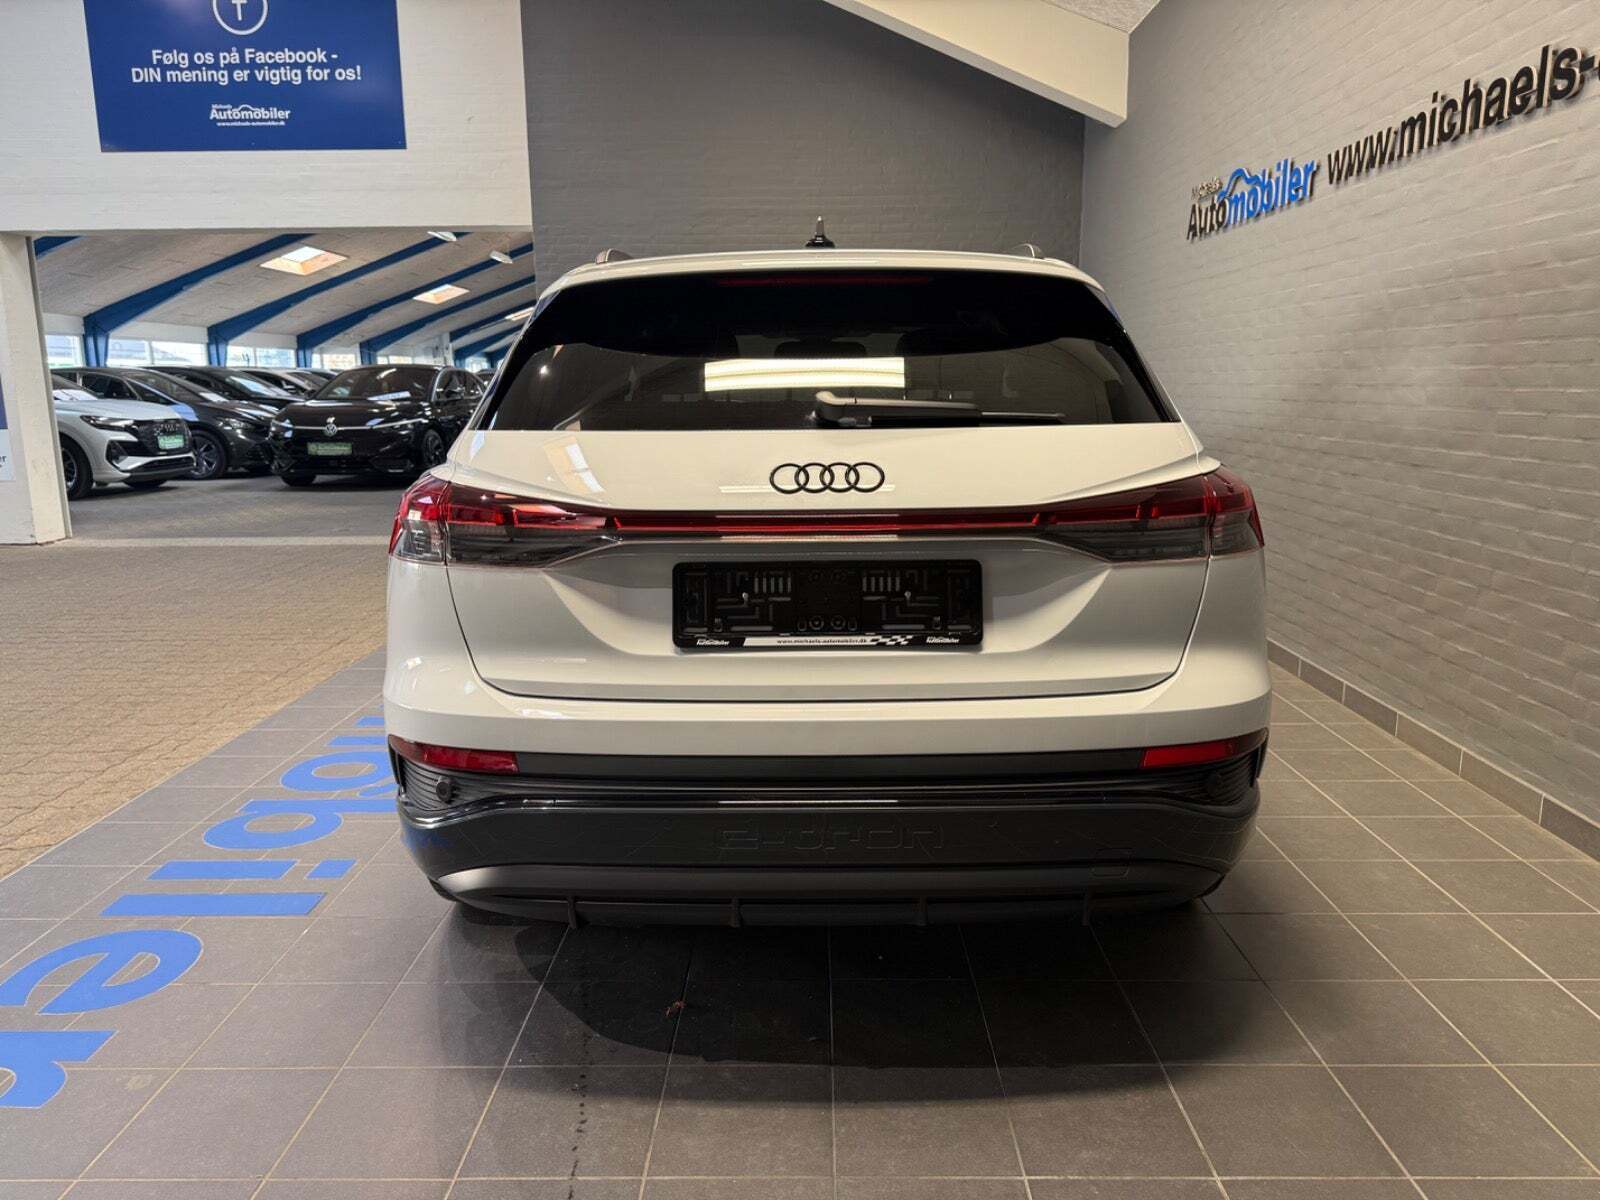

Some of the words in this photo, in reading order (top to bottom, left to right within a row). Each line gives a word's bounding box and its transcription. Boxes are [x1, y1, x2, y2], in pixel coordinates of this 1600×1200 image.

[152, 49, 189, 68] Følg
[194, 52, 214, 64] os
[220, 47, 240, 67] på
[245, 48, 327, 64] Facebook
[131, 67, 161, 83] DIN
[167, 66, 228, 86] mening
[233, 69, 250, 82] er
[255, 66, 302, 86] vigtig
[306, 65, 329, 81] for
[335, 65, 362, 80] os!
[209, 107, 291, 120] Automobiler
[1186, 158, 1318, 241] Automobiler
[1326, 44, 1600, 186] www.michaels-
